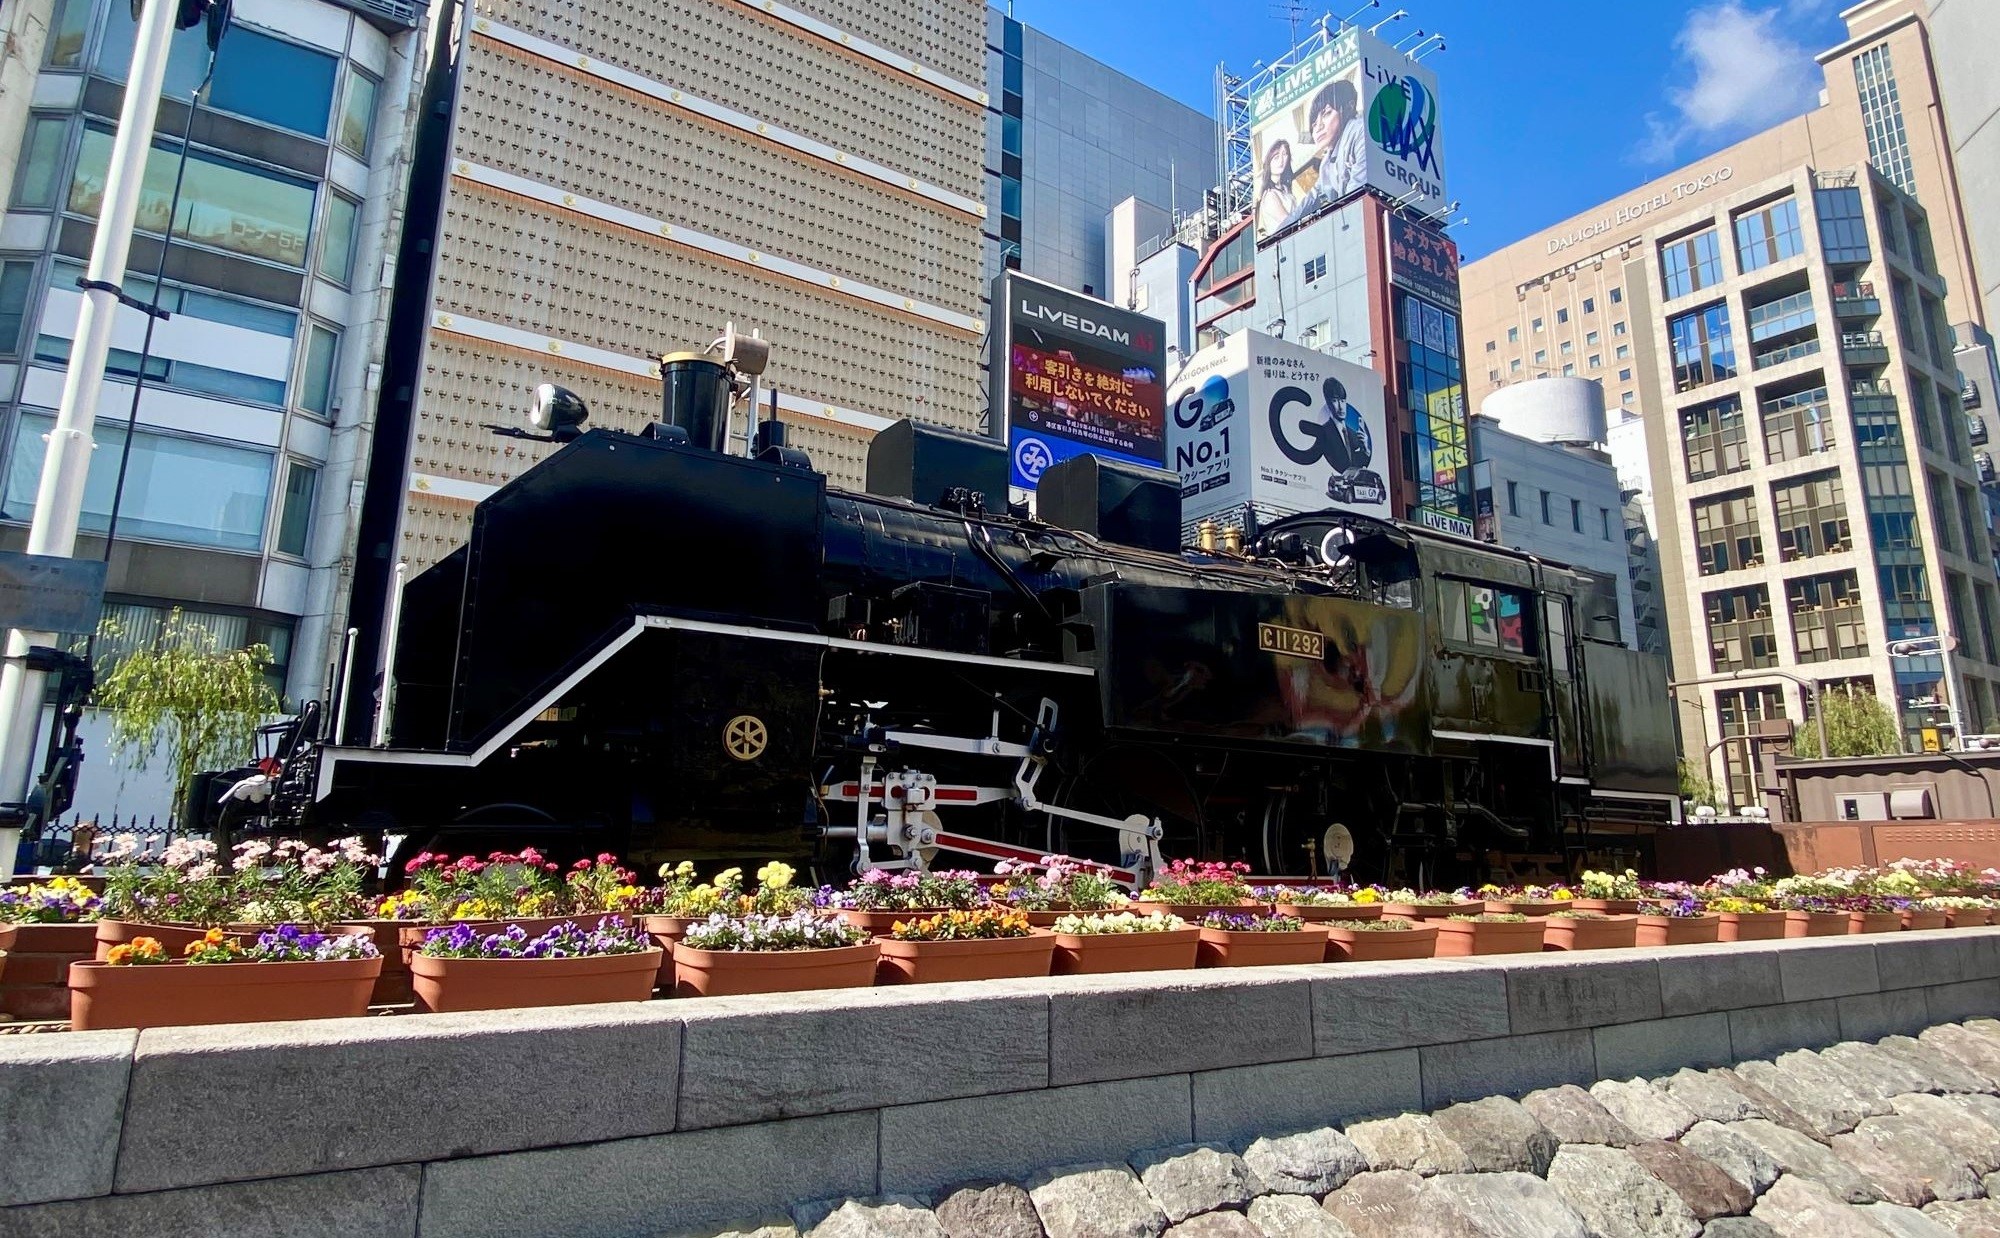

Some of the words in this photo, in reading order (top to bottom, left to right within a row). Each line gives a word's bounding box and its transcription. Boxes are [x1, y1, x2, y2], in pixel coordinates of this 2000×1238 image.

[1276, 62, 1312, 99] LiVE
[1315, 33, 1357, 74] MAX
[1276, 80, 1314, 108] MONTHLY
[1318, 52, 1359, 81] MANSION
[1364, 57, 1412, 101] LiVE
[1379, 96, 1440, 180] MAX
[1384, 159, 1441, 199] GROUP
[1546, 218, 1611, 255] DAI-ICHI
[1615, 192, 1672, 226] HOTEL
[1672, 166, 1734, 201] TOKYO
[1392, 239, 1457, 284] 始めました
[1403, 225, 1443, 256] オカマ
[1044, 359, 1134, 397] 客引きを絶対に
[1256, 355, 1306, 369] 新橋のみなさん
[1025, 372, 1151, 419] 利用しないでください
[1176, 426, 1230, 473] No.1
[1180, 458, 1230, 484] クシーアプリ
[1425, 513, 1447, 531] LiVE
[1449, 521, 1472, 538] MAX
